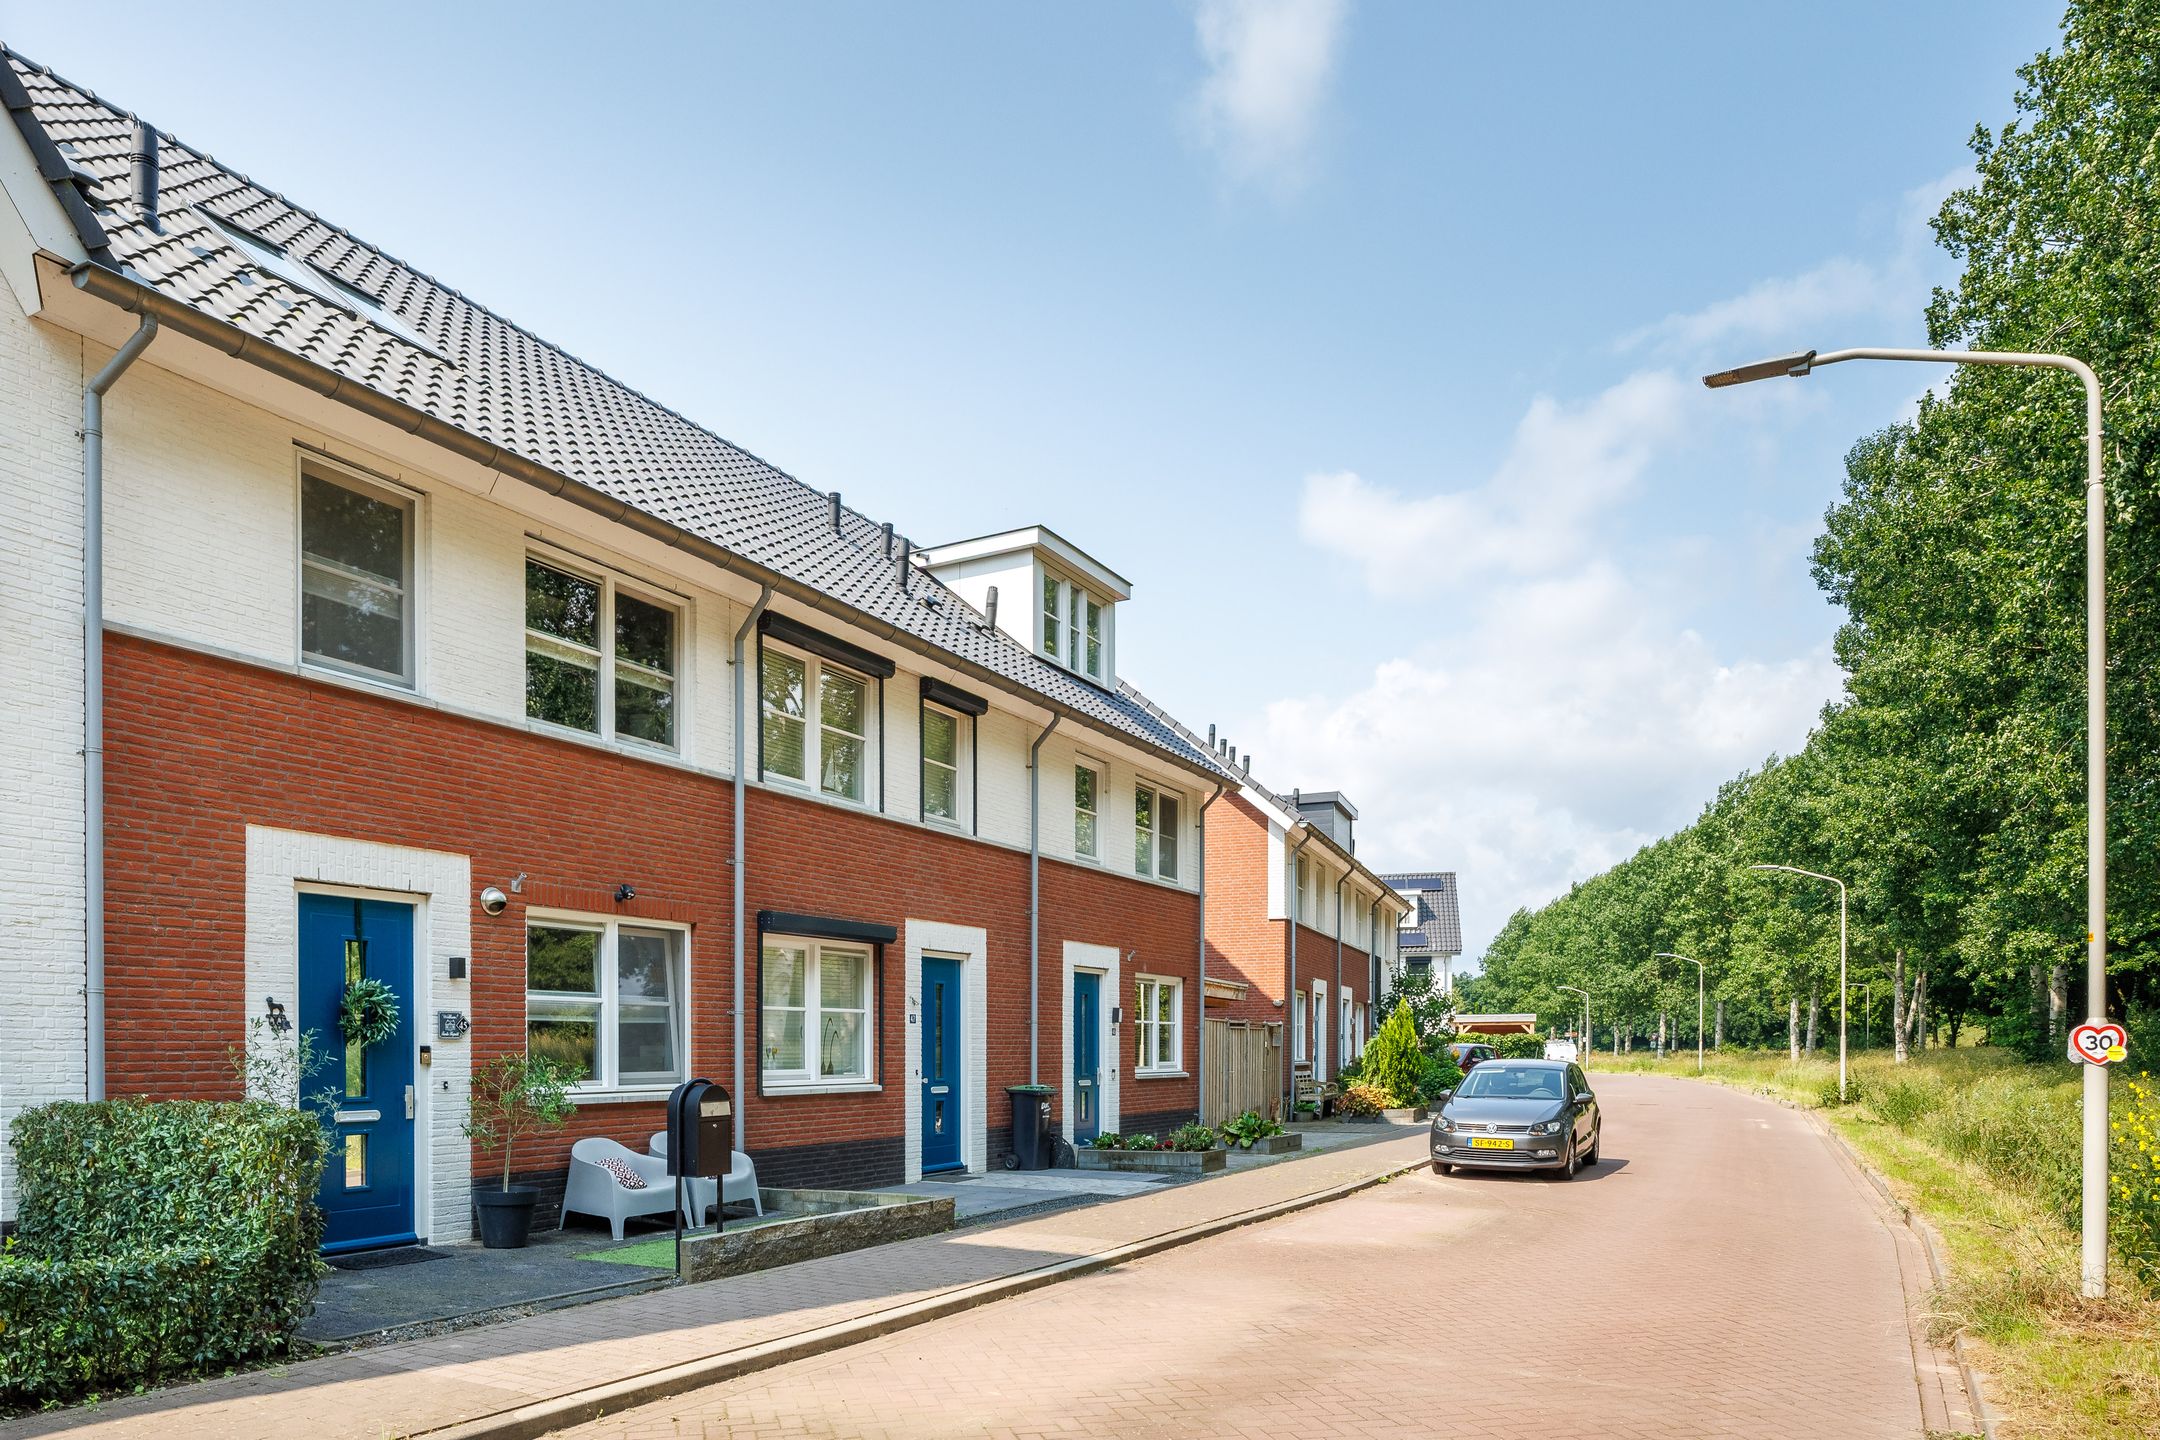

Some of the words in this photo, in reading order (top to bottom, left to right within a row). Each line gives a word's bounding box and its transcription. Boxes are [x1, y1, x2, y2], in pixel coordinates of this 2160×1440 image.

[459, 1021, 468, 1030] 45
[2085, 1035, 2112, 1050] 30
[1474, 1139, 1511, 1148] SF-942-S
